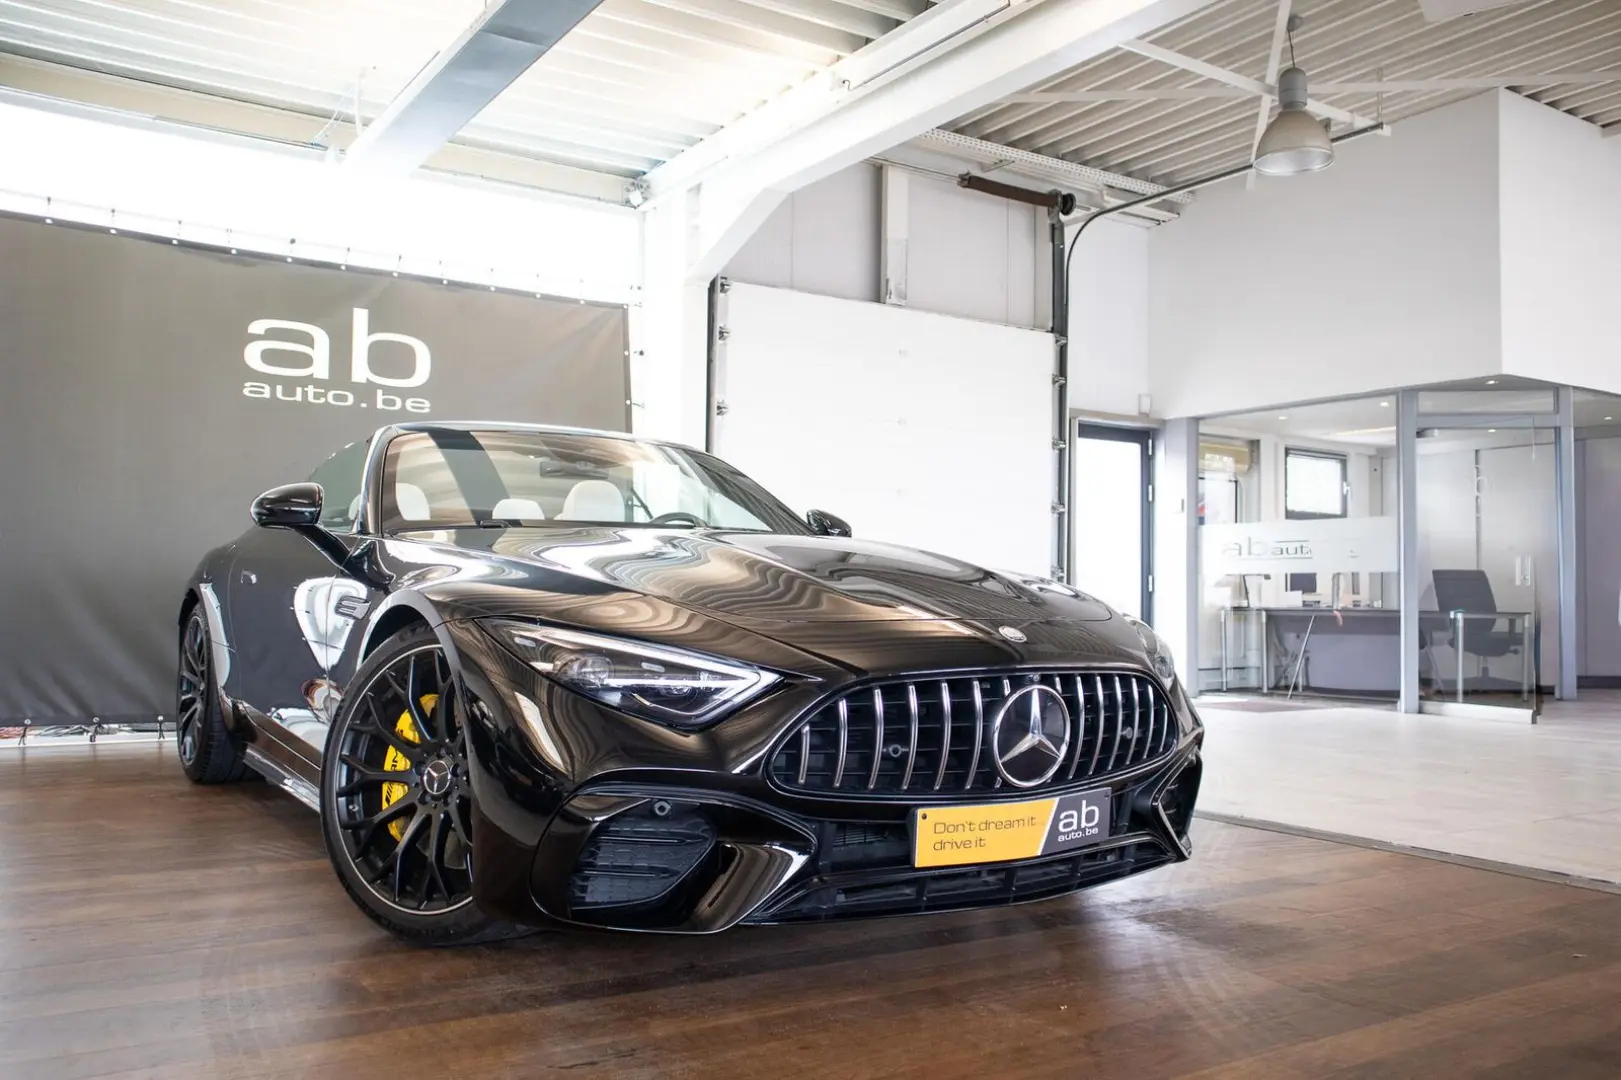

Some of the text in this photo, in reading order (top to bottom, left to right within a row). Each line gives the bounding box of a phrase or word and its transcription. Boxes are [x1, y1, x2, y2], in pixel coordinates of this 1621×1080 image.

[244, 307, 431, 388] ab
[242, 381, 431, 413] auto.be
[933, 816, 1036, 834] Don't dream it
[1058, 799, 1099, 832] ab
[933, 836, 986, 851] drive it
[1057, 827, 1099, 842] auto.be
